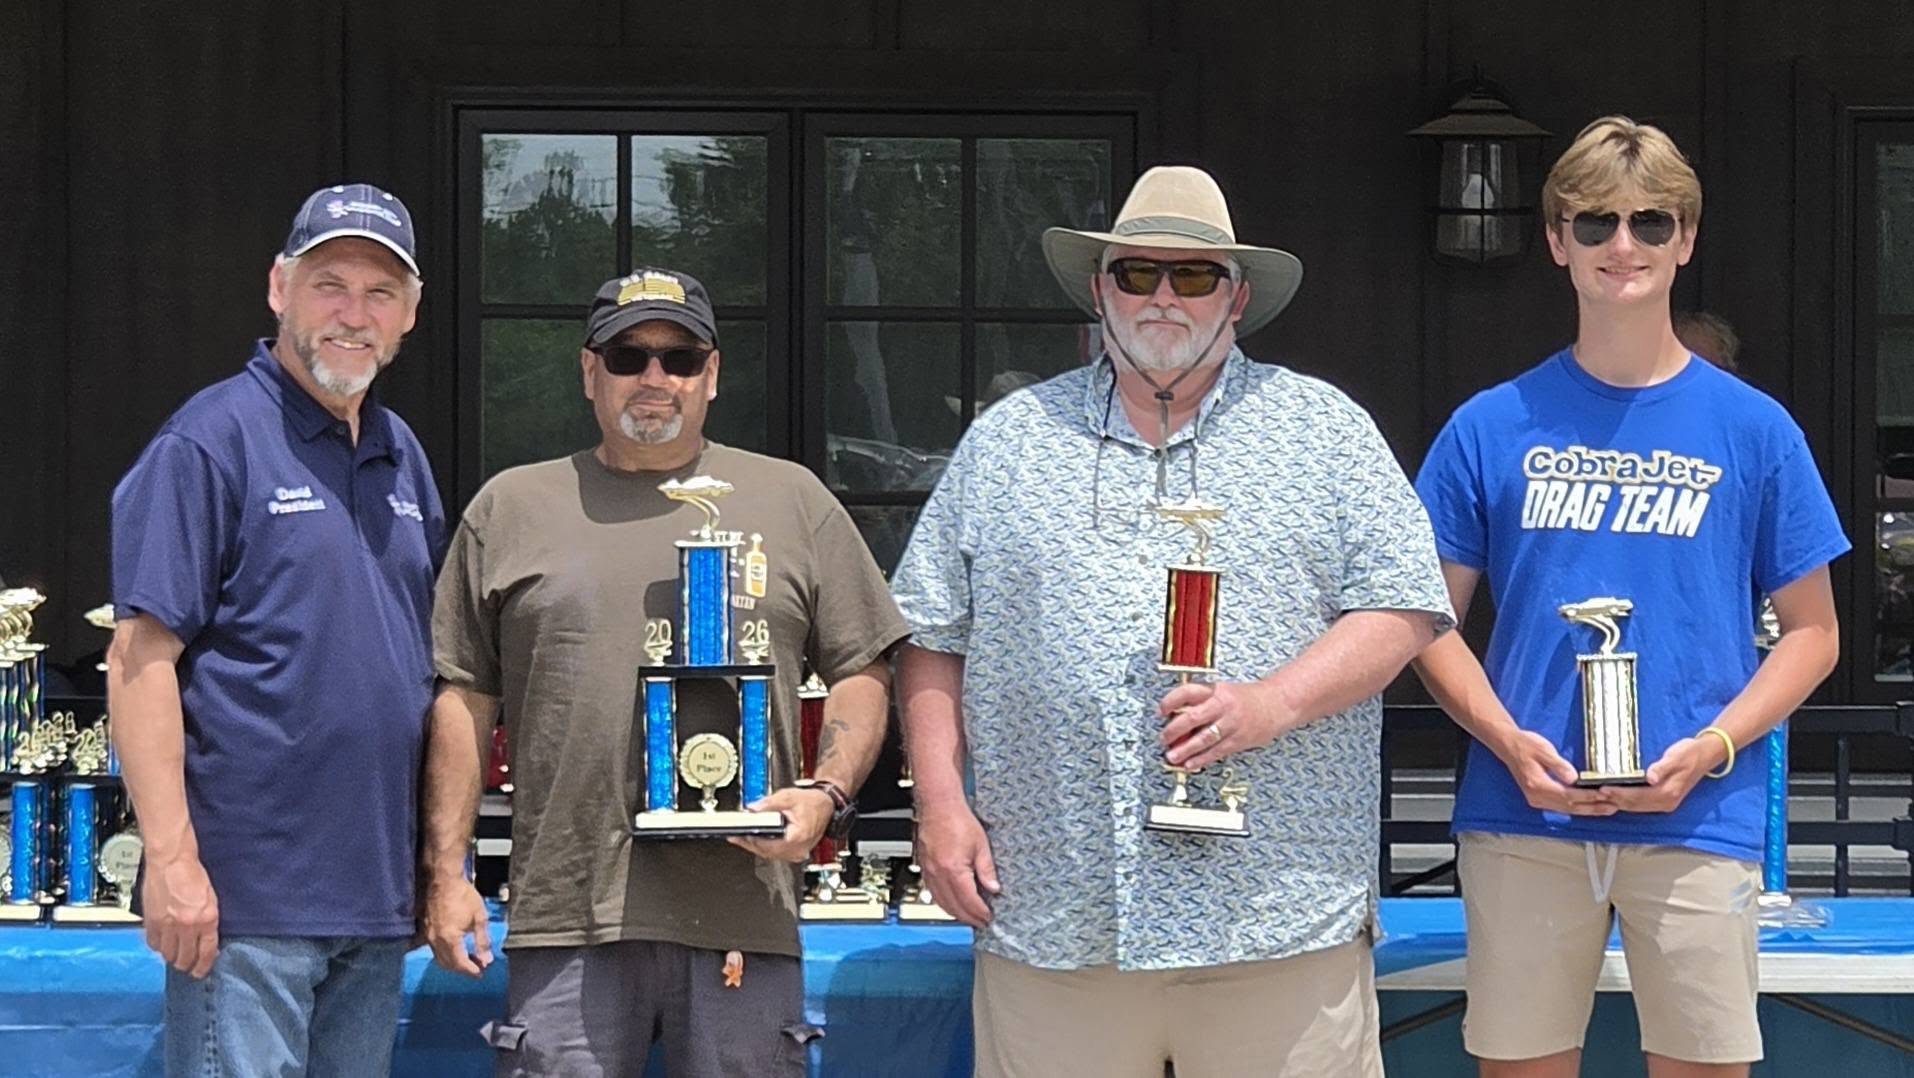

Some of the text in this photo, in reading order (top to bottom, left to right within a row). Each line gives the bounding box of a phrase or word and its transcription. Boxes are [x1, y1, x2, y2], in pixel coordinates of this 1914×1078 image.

[1523, 446, 1722, 490] CobraJet
[1521, 480, 1710, 538] DRAG TEAM
[644, 619, 770, 646] 20 26
[696, 764, 722, 773] Place
[703, 751, 716, 760] 1st
